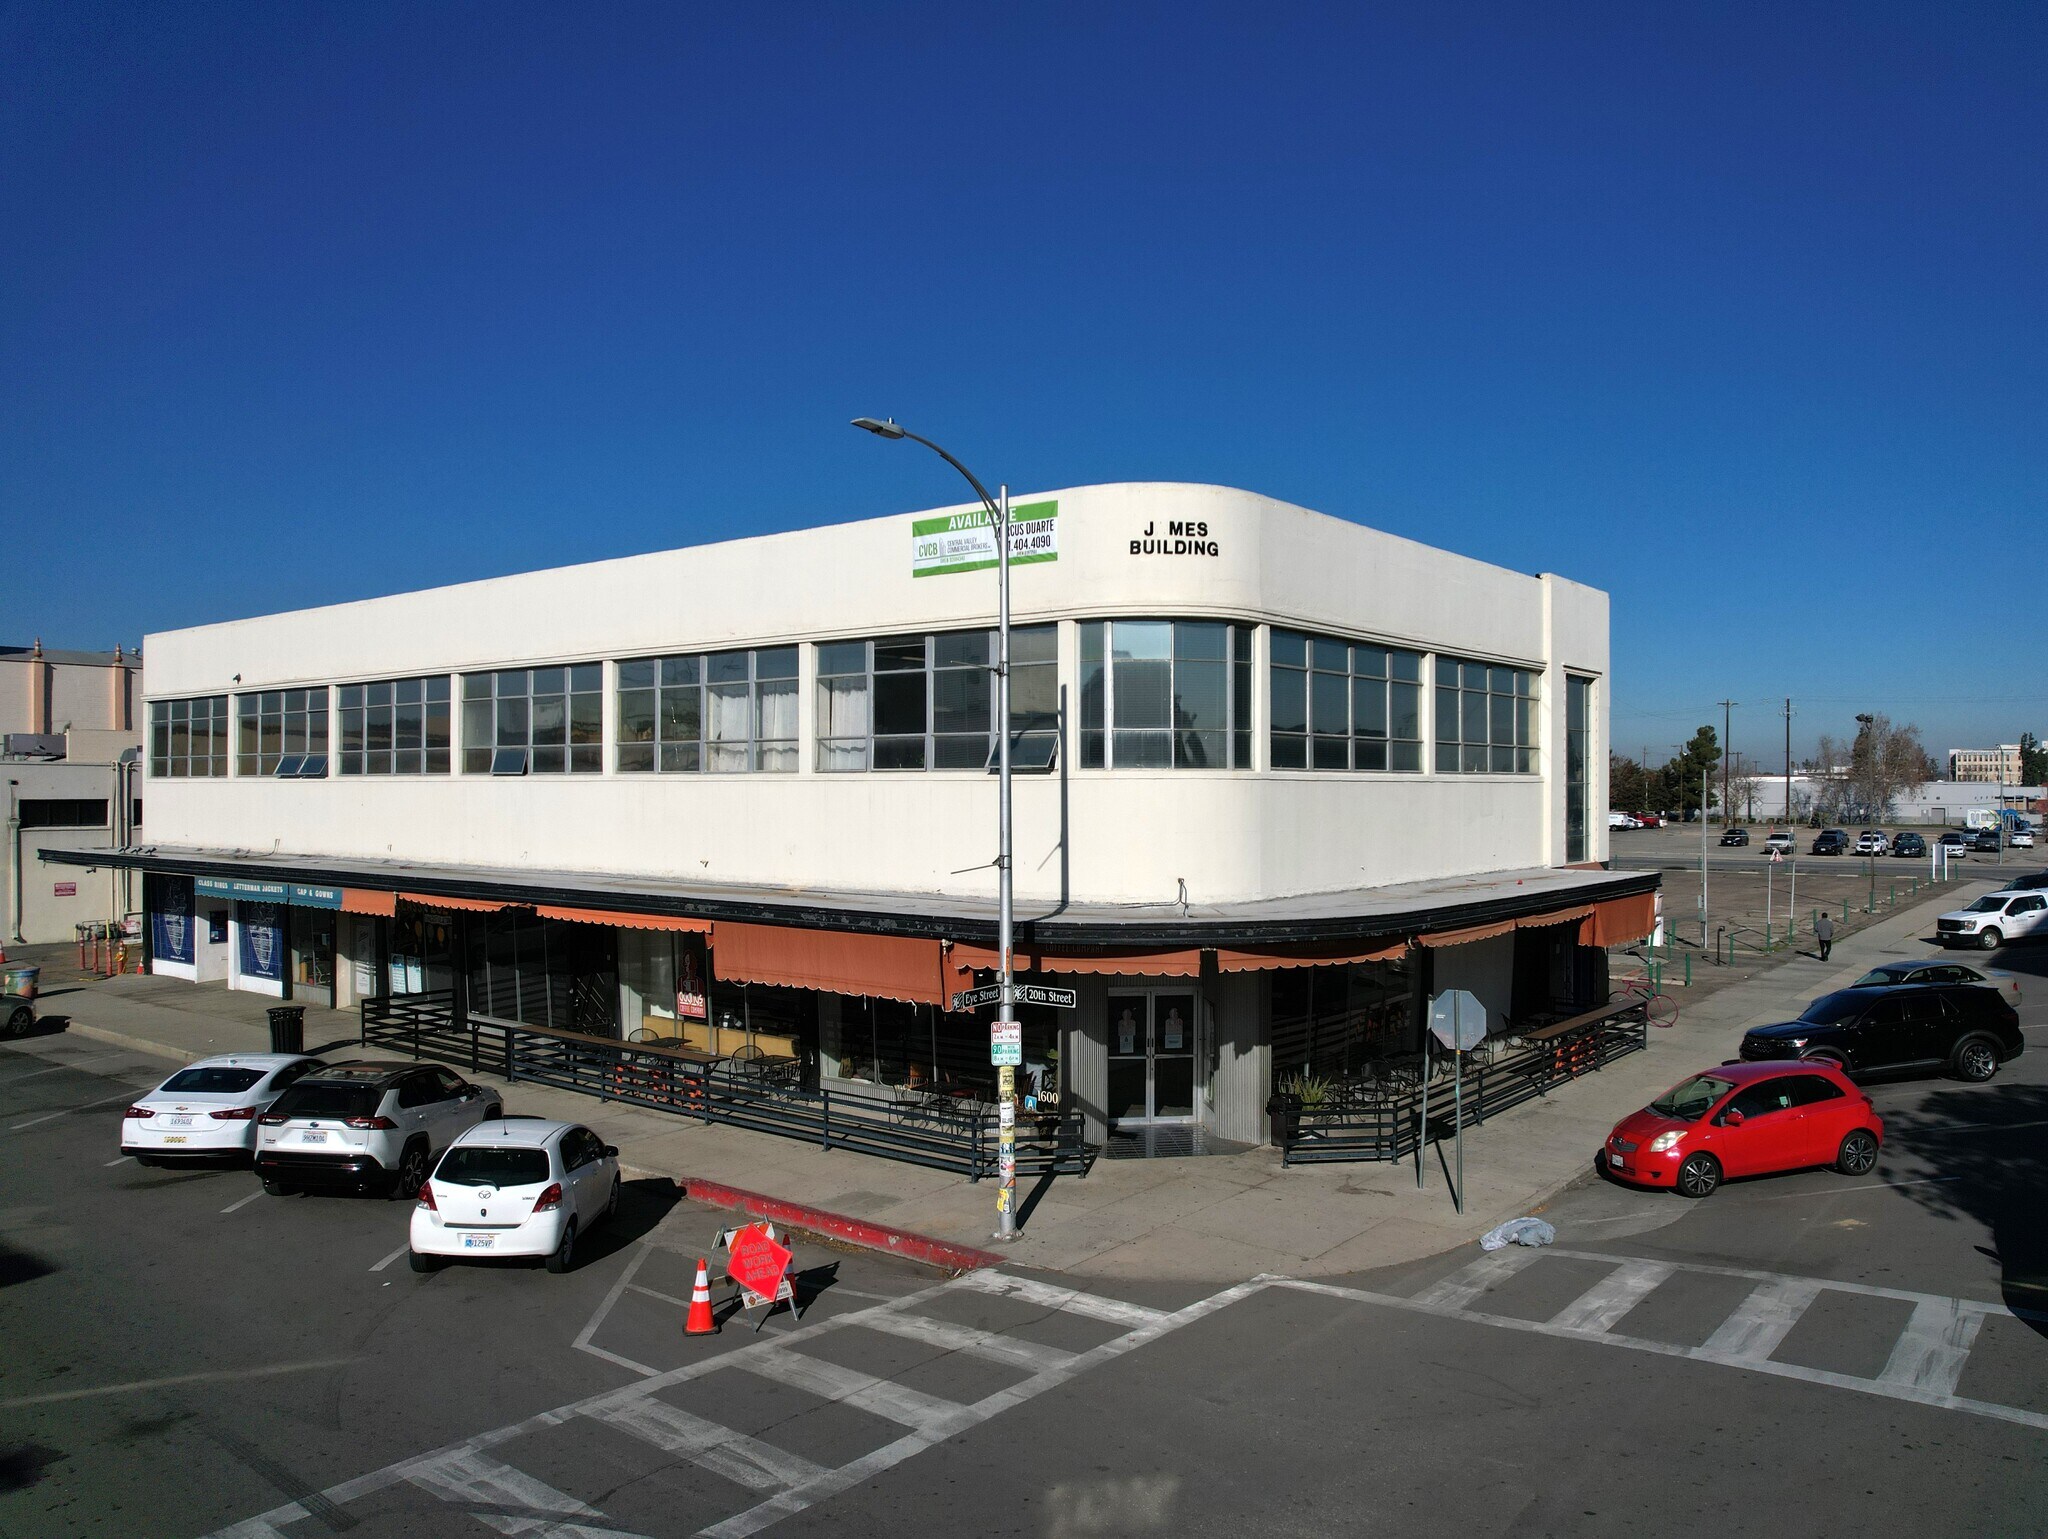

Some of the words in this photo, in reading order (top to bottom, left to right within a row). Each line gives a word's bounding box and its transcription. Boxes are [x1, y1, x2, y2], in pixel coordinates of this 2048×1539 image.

[949, 508, 1017, 530] AVAILAE
[1026, 519, 1054, 534] DUARTE
[918, 542, 938, 558] CVCB
[1007, 534, 1051, 552] 1.404.4090
[1130, 539, 1218, 557] BUILDING
[233, 883, 261, 892] LETTERMAN
[262, 885, 283, 893] JACKETS
[297, 888, 307, 896] CAP
[315, 890, 334, 899] GOWNS
[965, 994, 978, 1005] Eye
[980, 989, 999, 1001] Street
[1029, 990, 1046, 1001] 20th
[1048, 991, 1072, 1003] Street
[992, 1023, 1002, 1033] NO
[993, 1045, 1002, 1054] 90
[1038, 1090, 1059, 1104] 1600
[741, 1242, 770, 1256] ROAD
[743, 1252, 774, 1268] WORK
[746, 1265, 780, 1281] AHEAD
